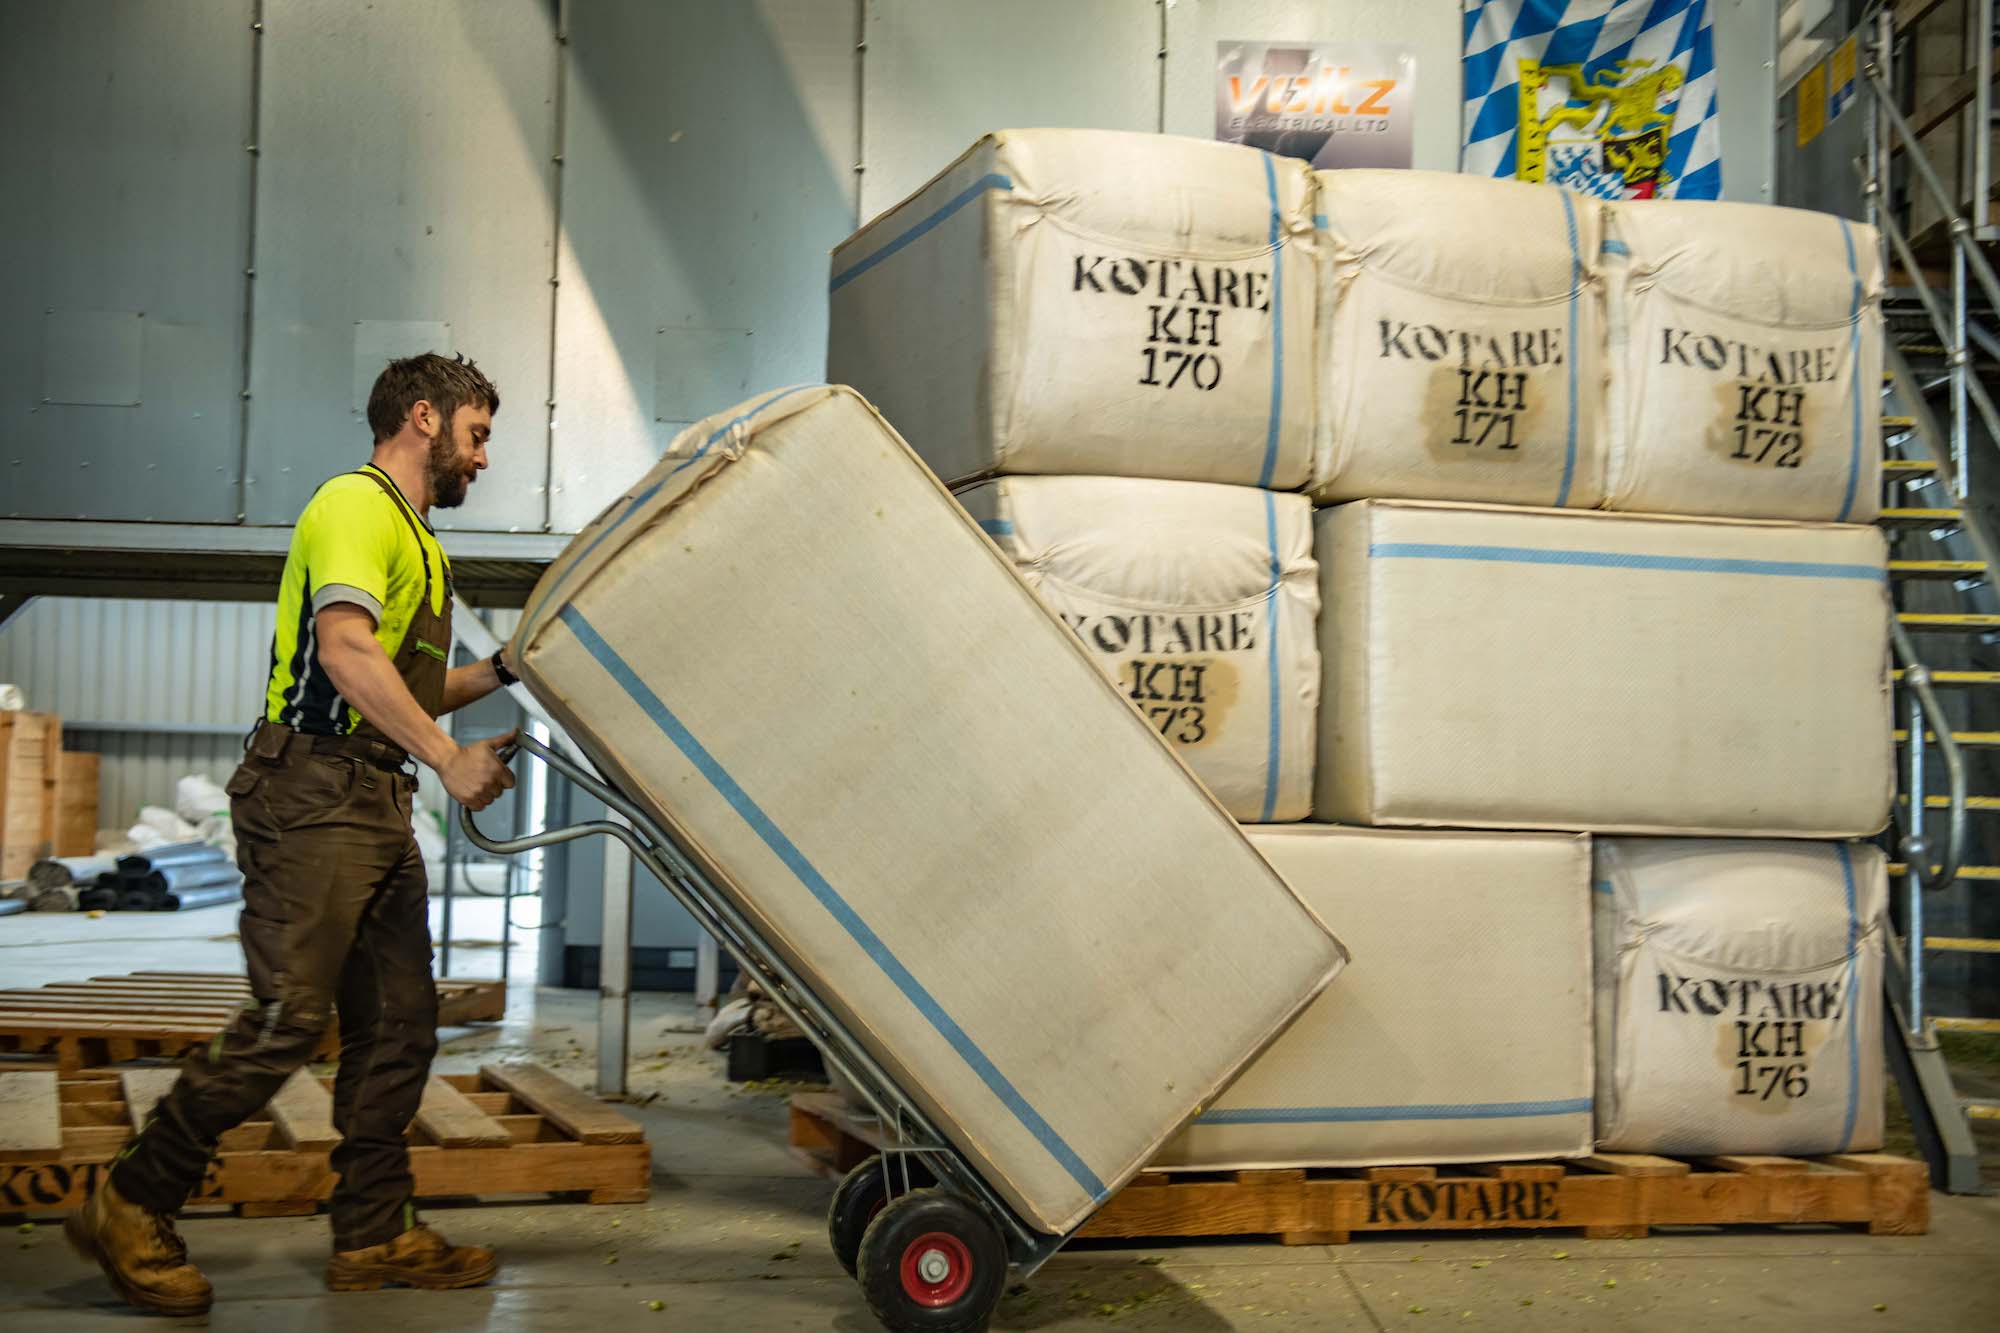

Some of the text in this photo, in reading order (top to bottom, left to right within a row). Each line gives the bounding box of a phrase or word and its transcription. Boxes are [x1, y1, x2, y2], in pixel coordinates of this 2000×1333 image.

[1230, 117, 1390, 132] ELECTRICAL LTD
[1072, 255, 1270, 313] KOTARE
[1147, 305, 1221, 346] KH
[1379, 319, 1563, 368] KOTARE
[1138, 348, 1221, 391] 170
[1660, 328, 1838, 385] KOTARE
[1457, 368, 1528, 410] KH
[1735, 384, 1806, 426] KH
[1451, 408, 1519, 450] 171
[1730, 424, 1804, 468] 172
[1129, 660, 1207, 703] KH
[1137, 703, 1206, 743] 73
[1657, 971, 1842, 1020] KOTARE
[1735, 1020, 1806, 1057] KH
[1735, 1060, 1808, 1100] 176
[1367, 1181, 1560, 1223] KOTARE
